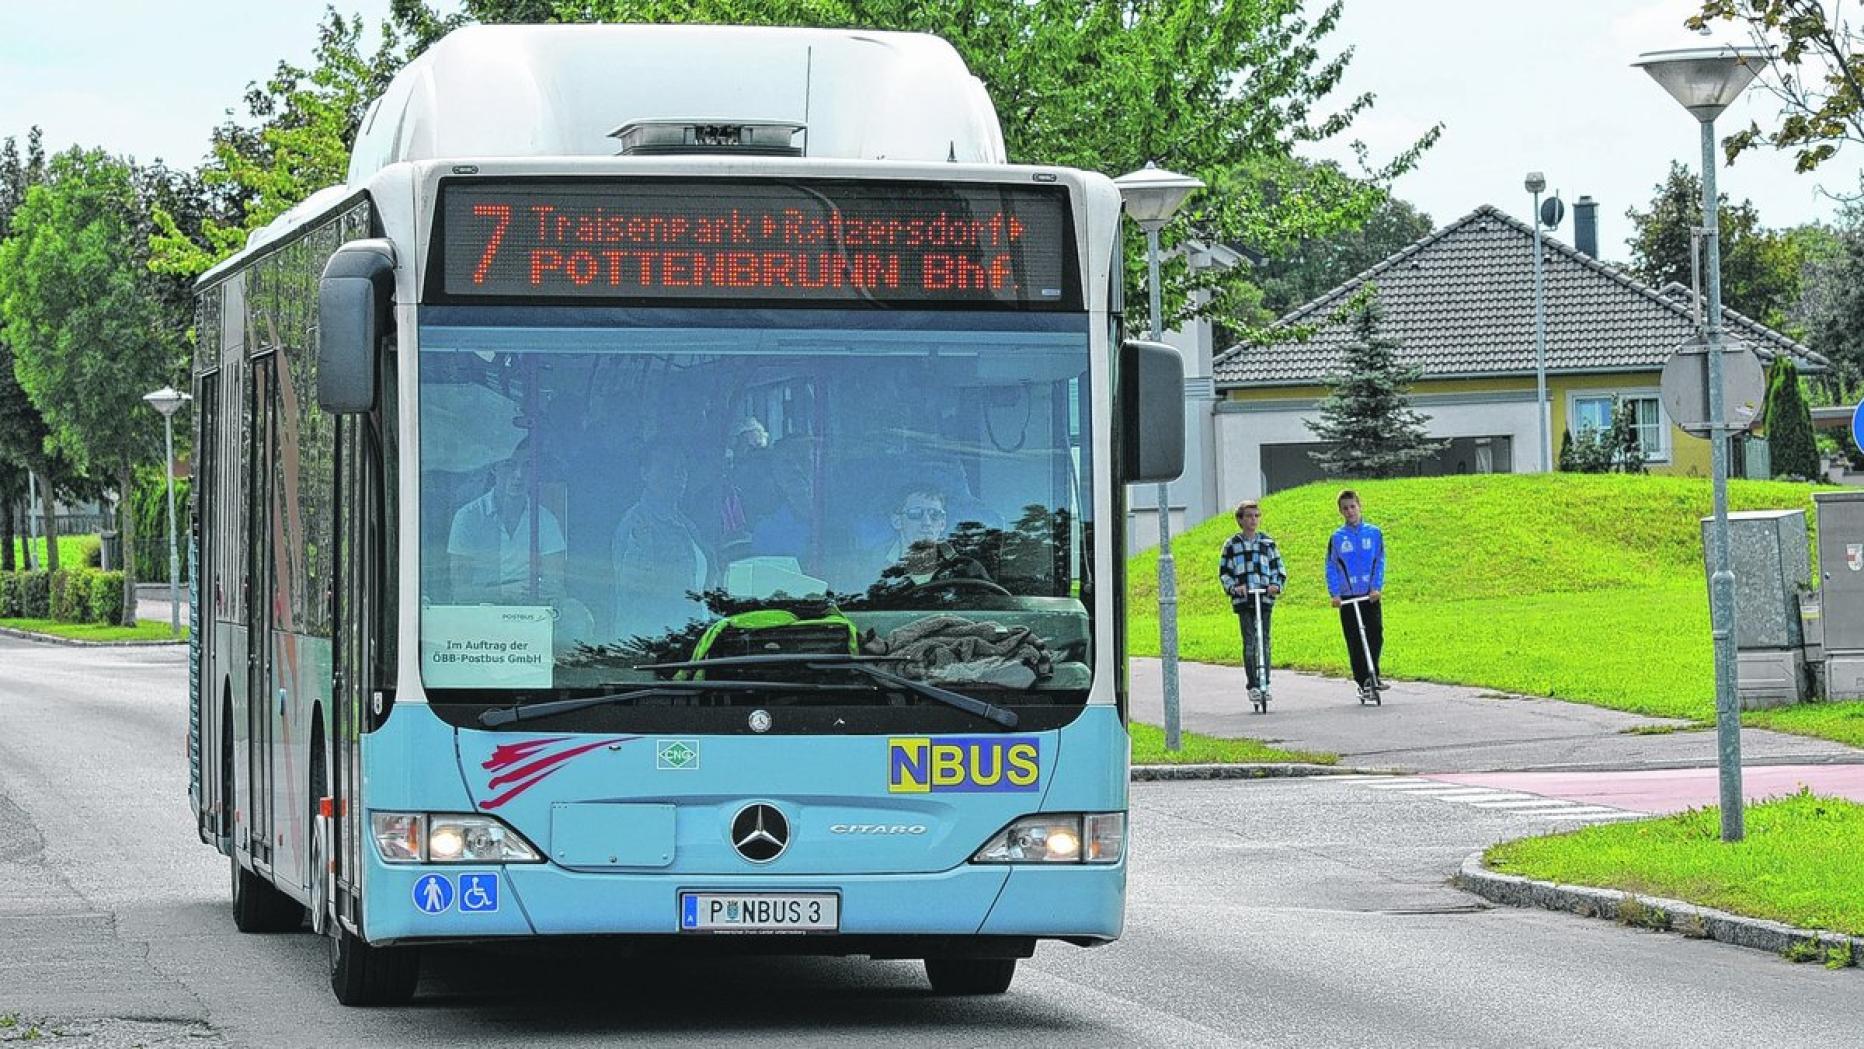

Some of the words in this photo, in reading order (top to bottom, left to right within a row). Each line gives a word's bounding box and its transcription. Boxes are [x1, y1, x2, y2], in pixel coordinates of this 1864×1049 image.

[531, 205, 753, 243] Traisenpark
[473, 204, 509, 286] 7
[531, 250, 899, 289] POTTENBRUNN
[433, 651, 505, 663] ÖBB-Postbus
[507, 653, 541, 663] GmbH
[446, 641, 462, 650] Im
[465, 640, 507, 651] Auftrag
[510, 641, 528, 650] der
[665, 750, 691, 760] CNG
[890, 743, 1039, 786] NBUS
[830, 824, 928, 834] CITARO
[710, 900, 723, 923] P
[742, 900, 801, 923] NBUS
[808, 900, 821, 923] 3
